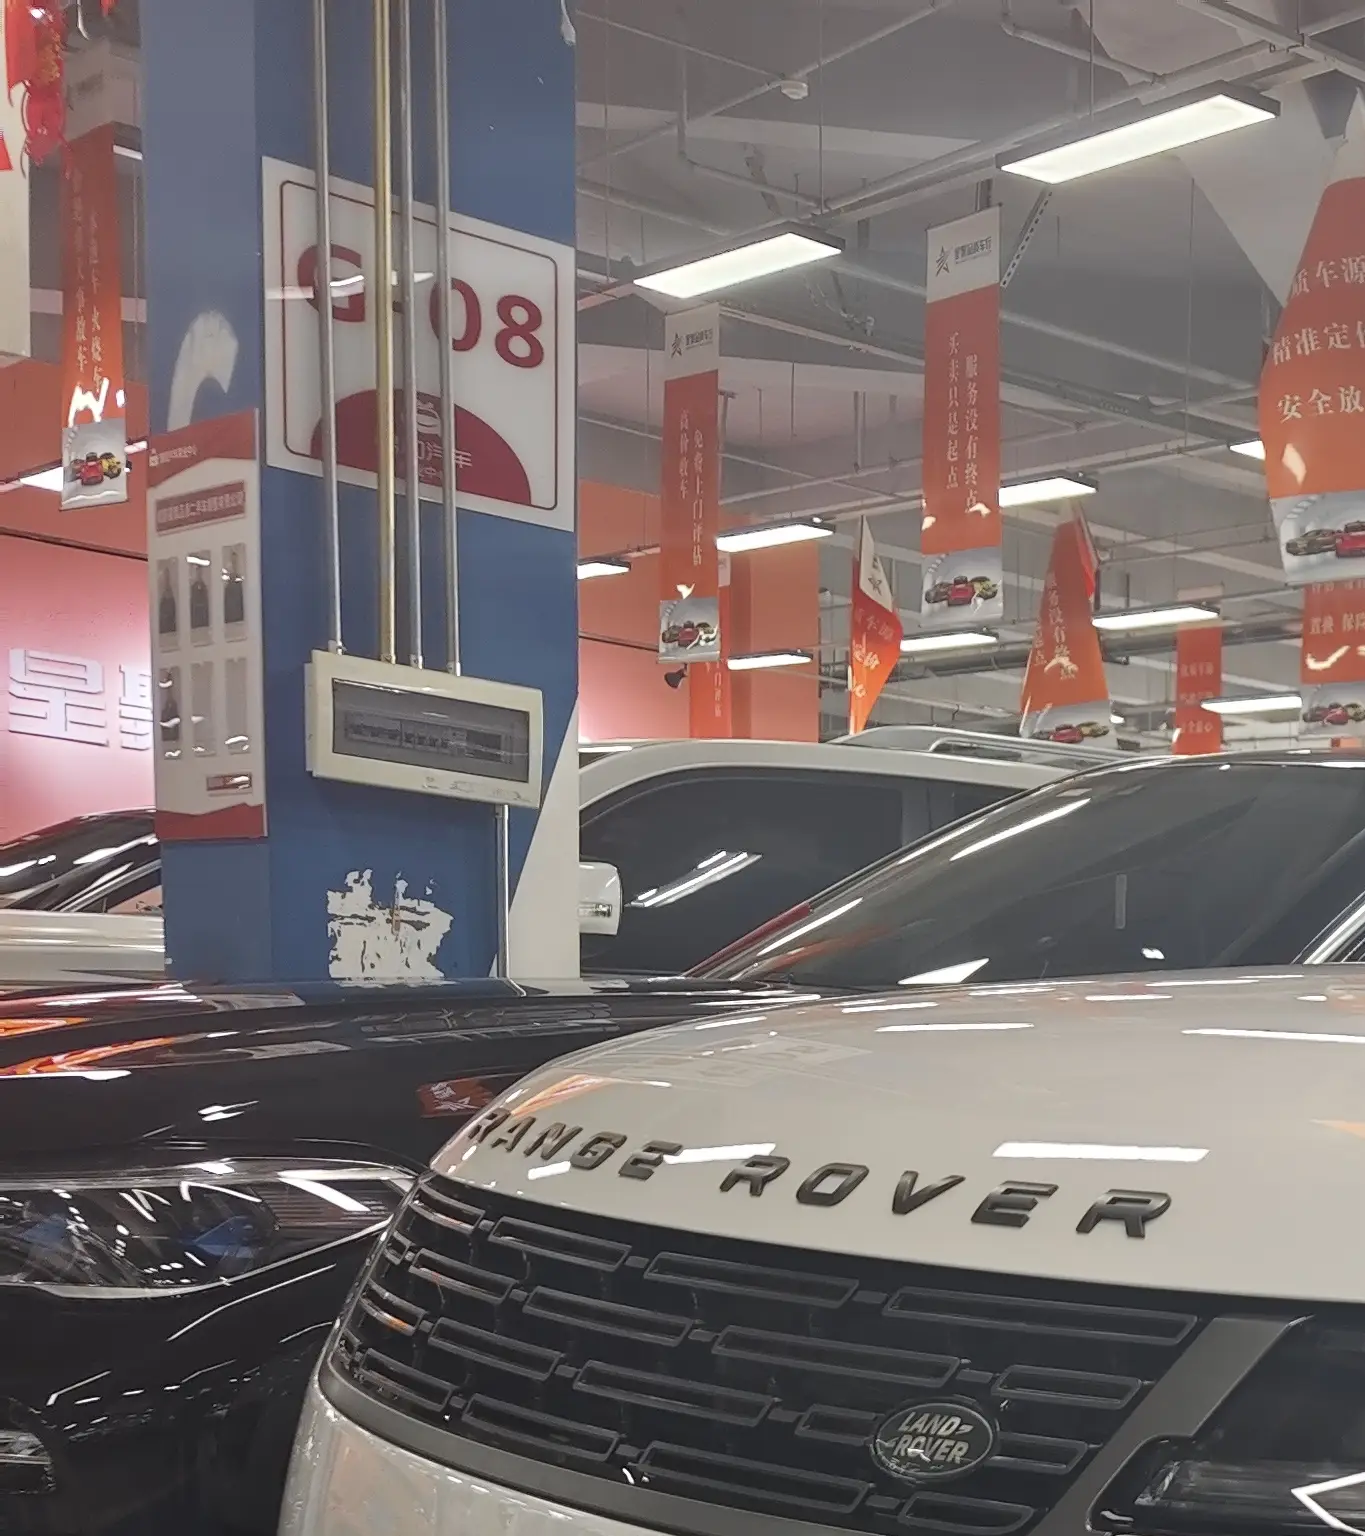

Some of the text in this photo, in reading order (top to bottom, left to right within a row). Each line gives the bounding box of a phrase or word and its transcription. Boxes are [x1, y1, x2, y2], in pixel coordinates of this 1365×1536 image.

[963, 353, 979, 513] 服务没有终点
[467, 1107, 1173, 1239] RANGE ROVER
[892, 1434, 969, 1464] ROVER
[898, 1411, 962, 1436] LAND
